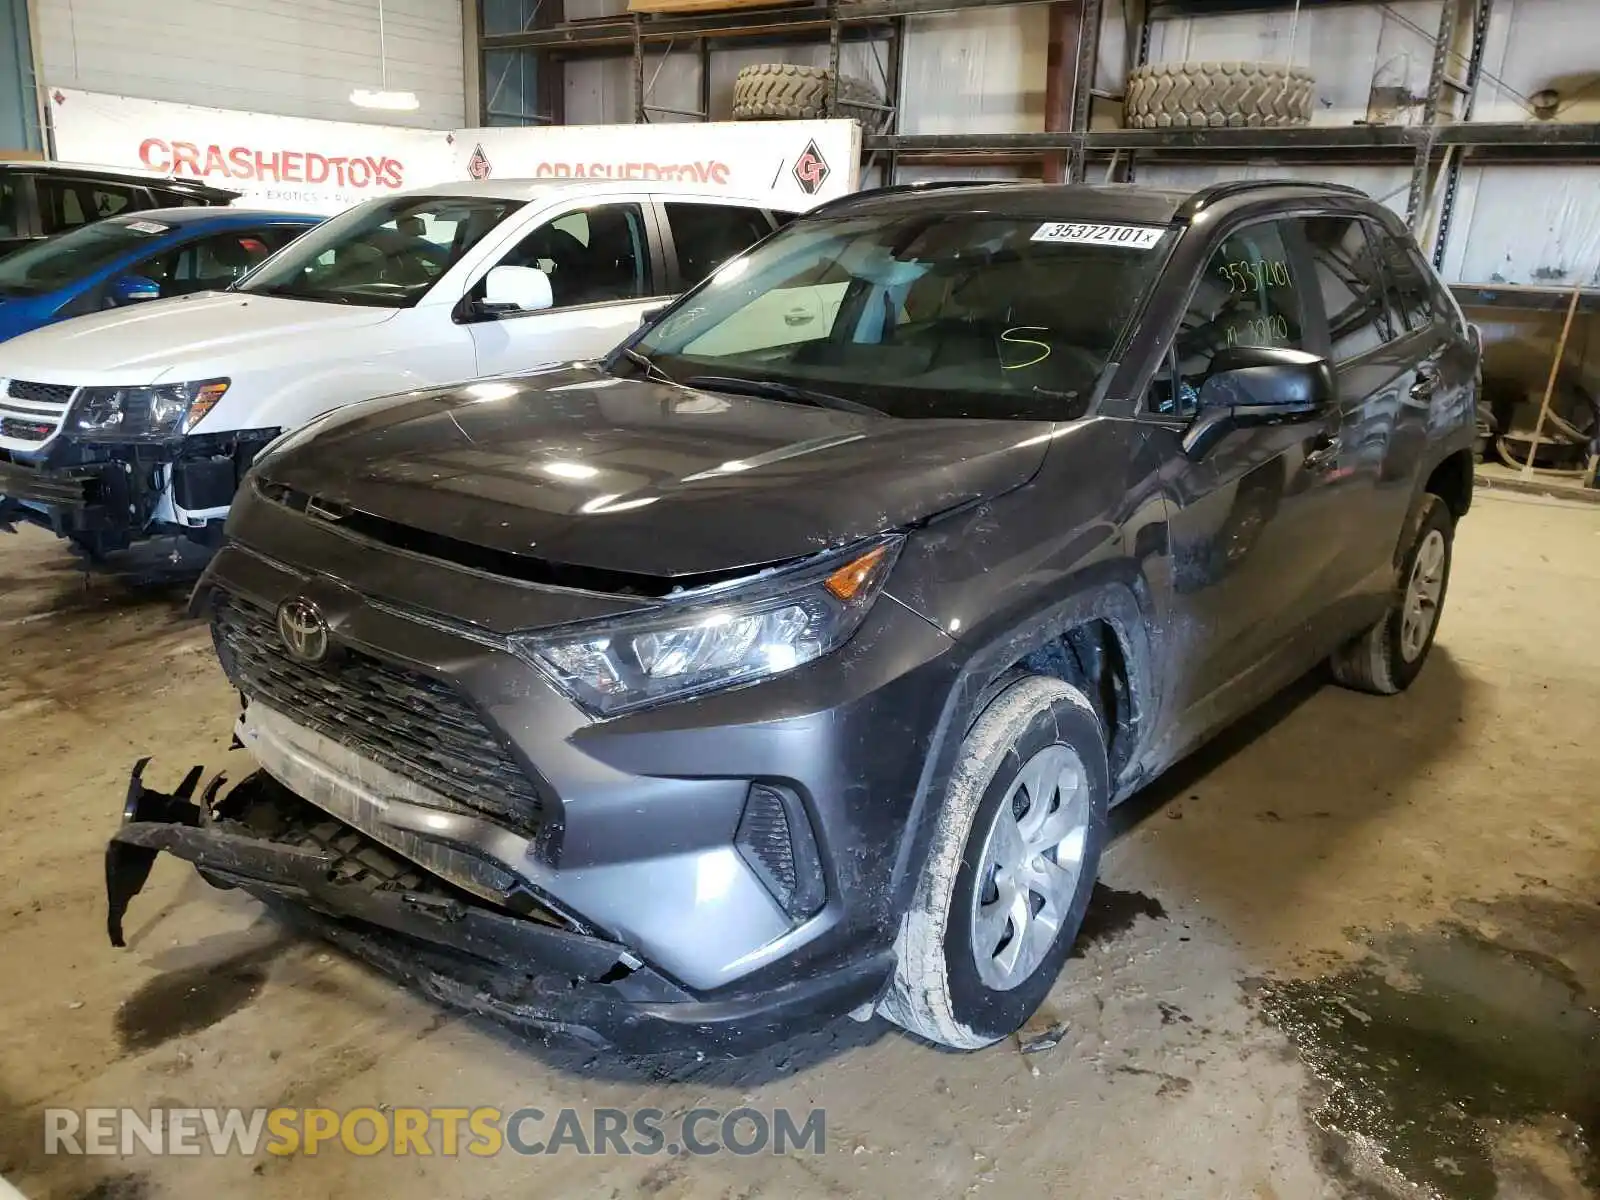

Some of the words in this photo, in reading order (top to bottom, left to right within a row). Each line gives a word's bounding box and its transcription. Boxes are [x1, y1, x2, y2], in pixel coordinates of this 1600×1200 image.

[138, 137, 405, 189] CRASHEDTOYS
[267, 189, 320, 203] EXOTICS
[1218, 259, 1294, 293] 35372101
[1001, 325, 1051, 369] S
